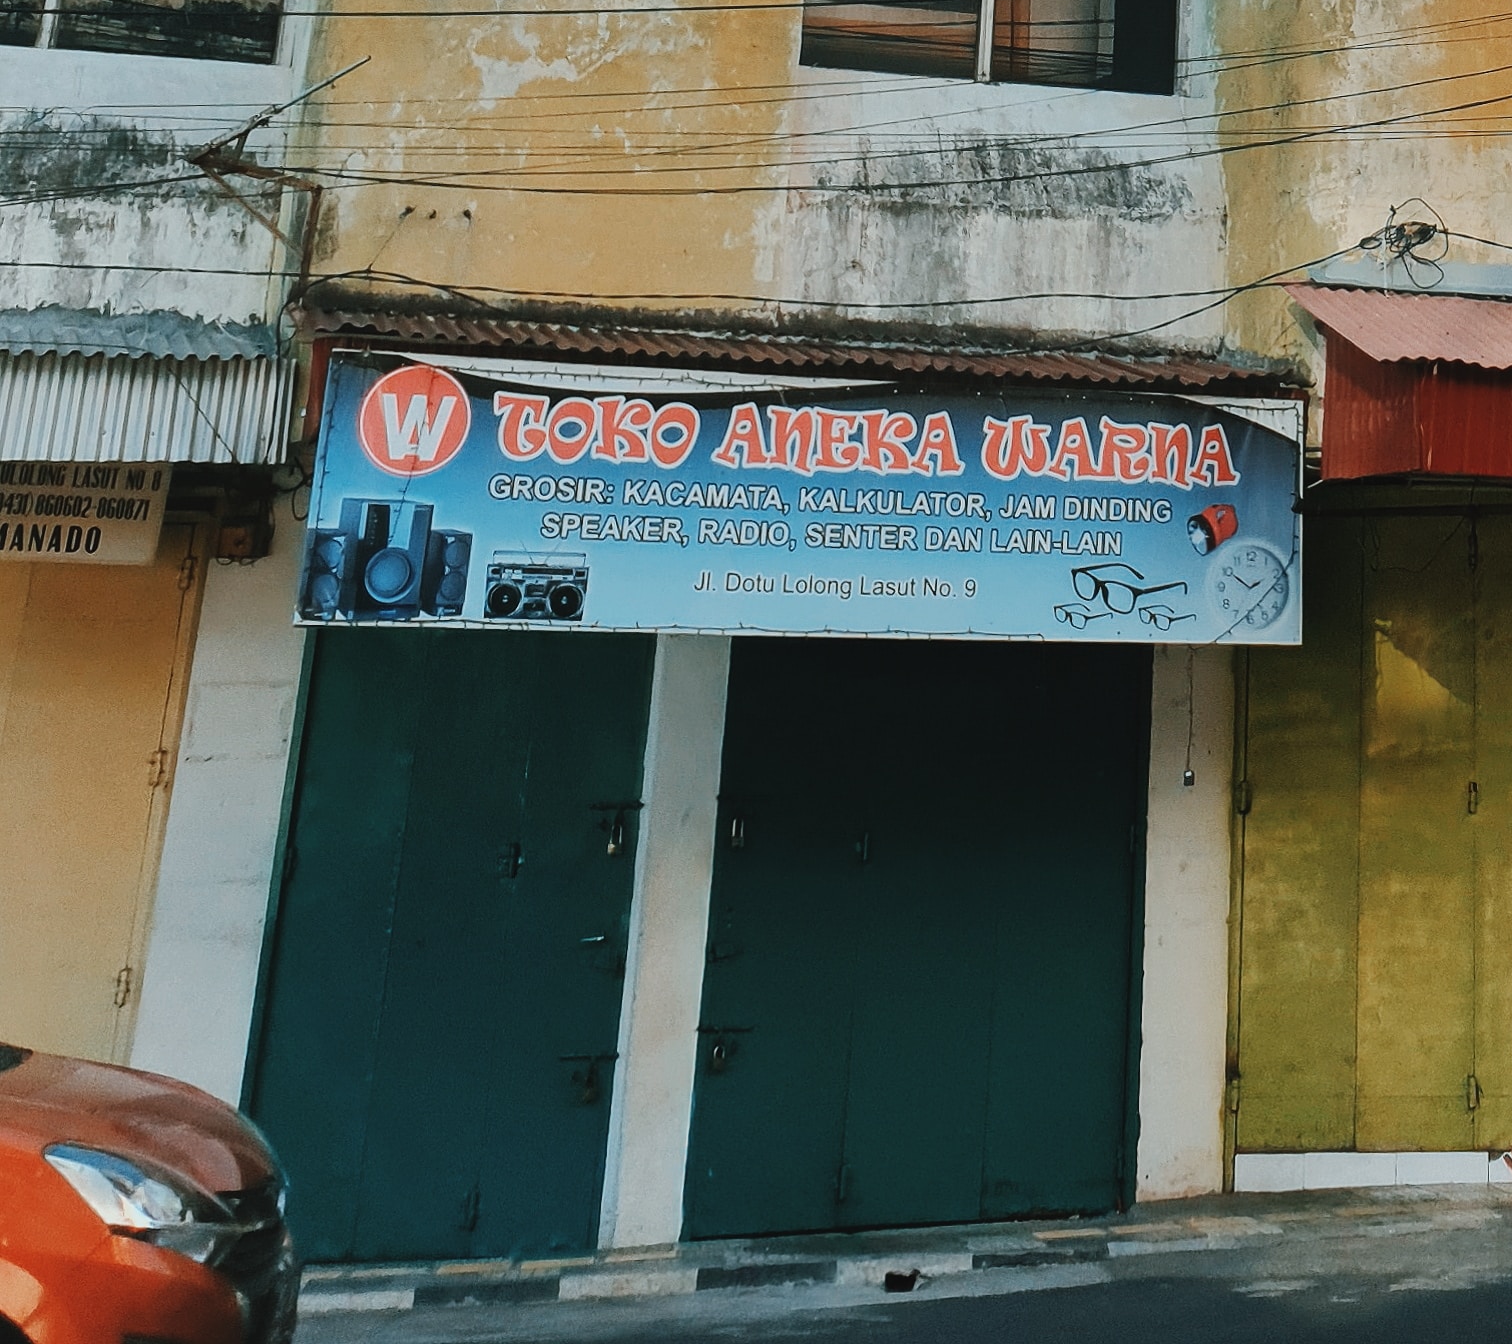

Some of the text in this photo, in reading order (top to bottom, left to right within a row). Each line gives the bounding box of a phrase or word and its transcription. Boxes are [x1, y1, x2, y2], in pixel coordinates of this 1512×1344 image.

[494, 390, 1241, 490] TOKO ANEKA WARNA
[72, 465, 120, 490] LASUT
[126, 468, 146, 491] NO
[152, 470, 163, 492] 8
[488, 473, 1173, 523] GROSIR: KACAMATA, KALKULATOR, JAM DINDING
[540, 513, 1123, 556] SPEAKER, RADIO, SENTER DAN LAIN-LAIN
[694, 571, 977, 599] Jl. Dotu Lolong Lasut No. 9
[1222, 598, 1231, 609] 8
